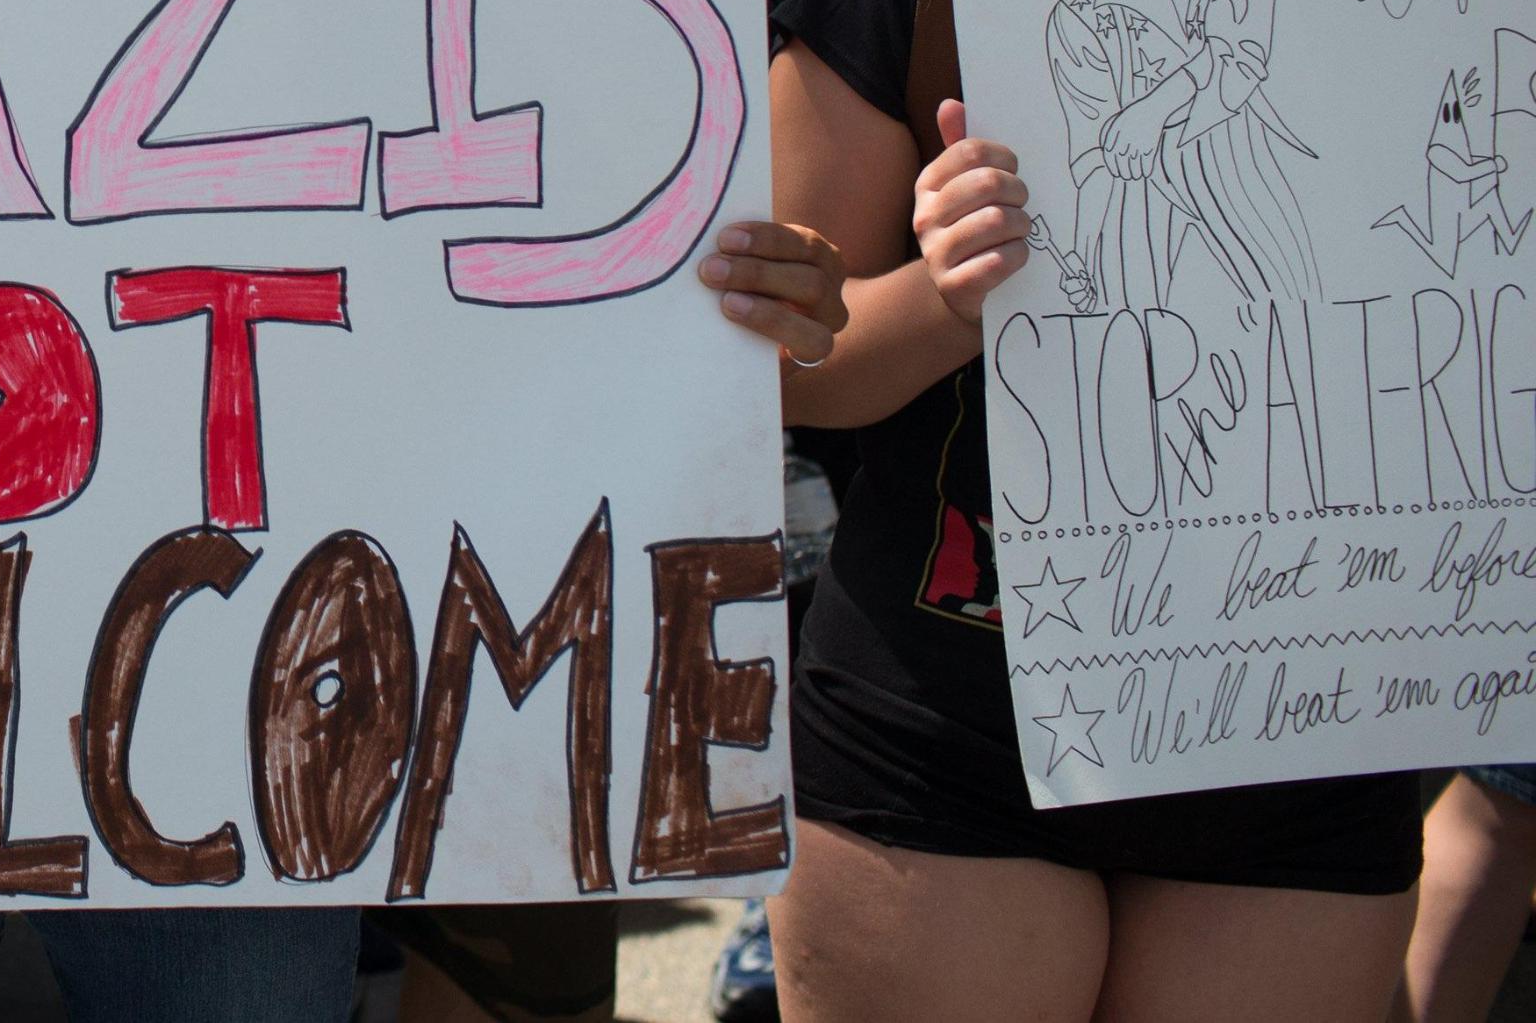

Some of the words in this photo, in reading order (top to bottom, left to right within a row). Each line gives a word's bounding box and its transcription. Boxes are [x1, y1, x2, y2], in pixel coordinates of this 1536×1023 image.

[996, 307, 1200, 525] STOP
[1164, 349, 1248, 507] the
[1100, 529, 1176, 638] We
[1216, 530, 1319, 622] beat
[1339, 543, 1406, 590] 'em
[1118, 656, 1248, 765] We'll
[1255, 661, 1362, 742] beat
[1375, 676, 1440, 719] 'em
